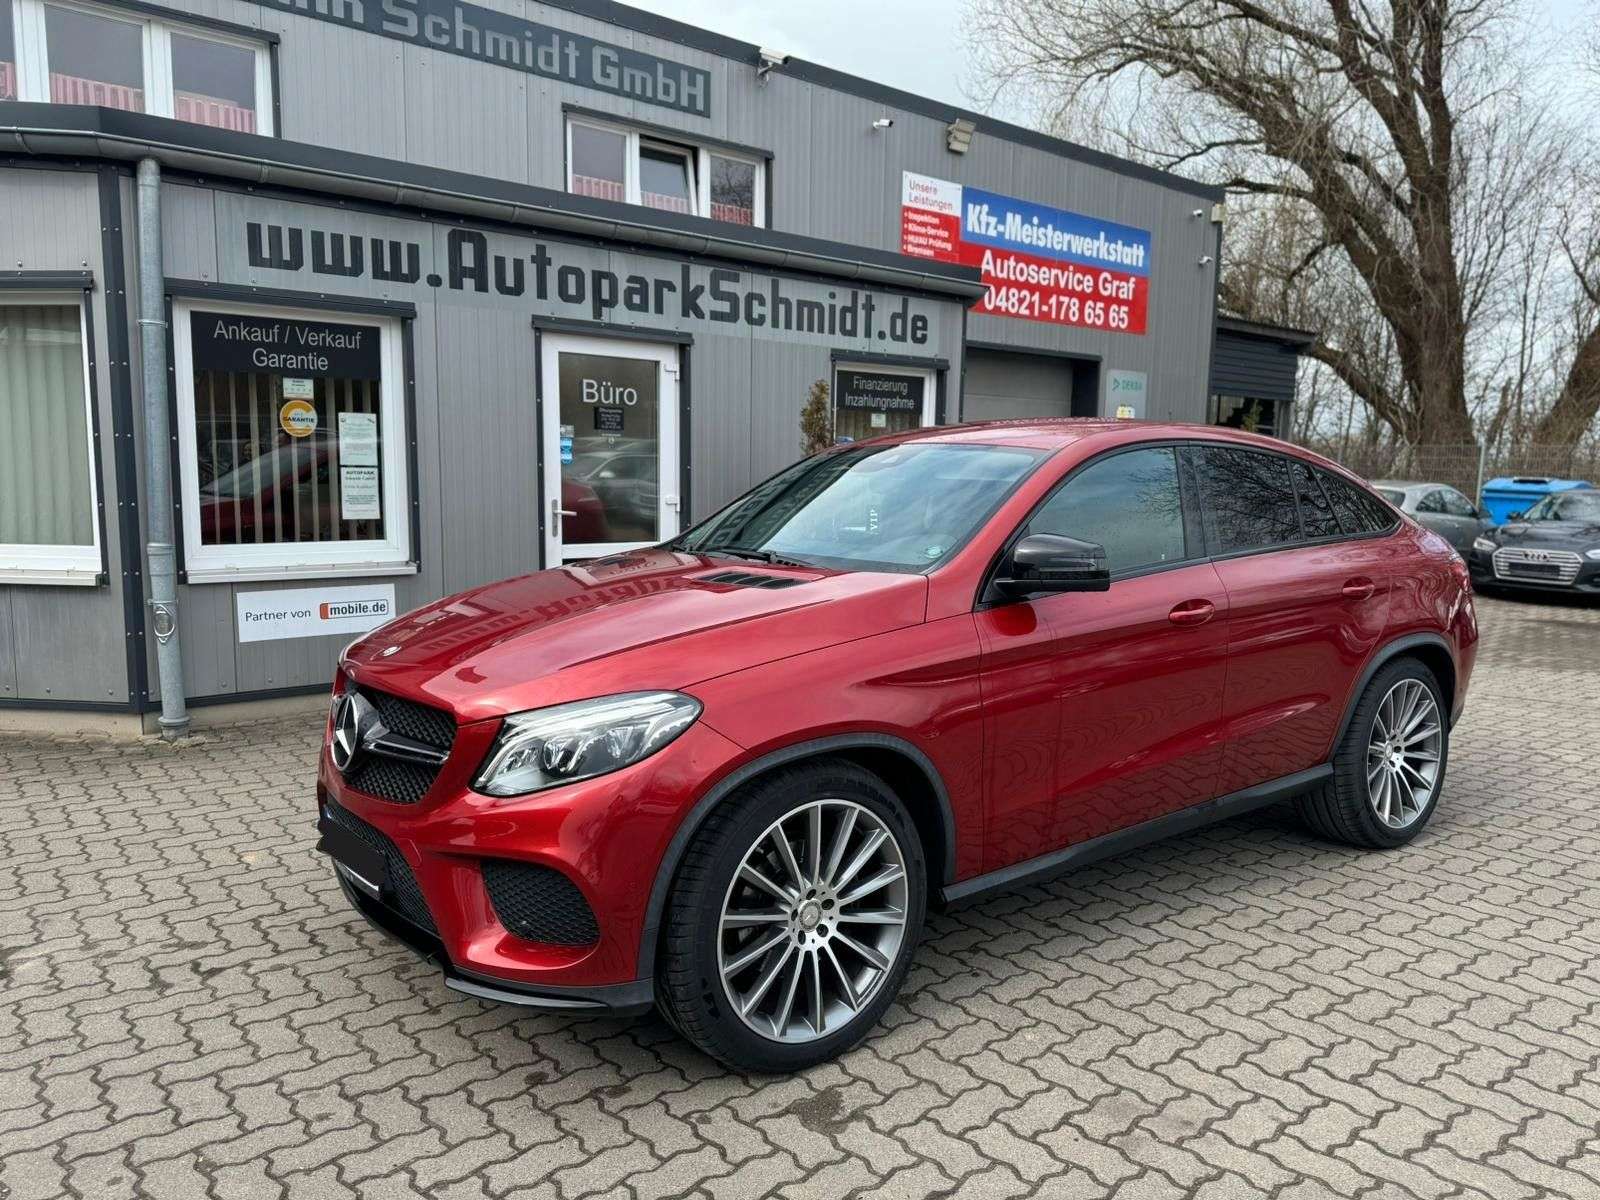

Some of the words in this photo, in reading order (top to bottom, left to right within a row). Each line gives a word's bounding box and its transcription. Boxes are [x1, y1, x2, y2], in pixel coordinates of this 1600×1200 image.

[382, 0, 580, 79] Schmidt
[591, 45, 705, 112] GmbH
[909, 179, 938, 195] Unsere
[909, 191, 953, 210] Leistungen
[966, 202, 1145, 267] Kfz-Meisterwerkstatt
[246, 222, 928, 345] www.AutoparkSchmidt.de
[981, 249, 1094, 294] Autoservice
[1098, 271, 1136, 300] Graf
[984, 285, 1079, 322] 04821-178
[1084, 300, 1104, 326] 65
[1108, 304, 1129, 329] 65
[213, 319, 280, 343] Ankauf
[295, 326, 362, 350] Verkauf
[252, 347, 329, 370] Garantie
[582, 378, 638, 406] Büro
[853, 375, 908, 396] Finanzierung
[845, 391, 915, 411] Inzahlungnahme
[245, 611, 288, 622] Partner
[291, 608, 311, 619] von
[329, 602, 386, 616] mobile.de
